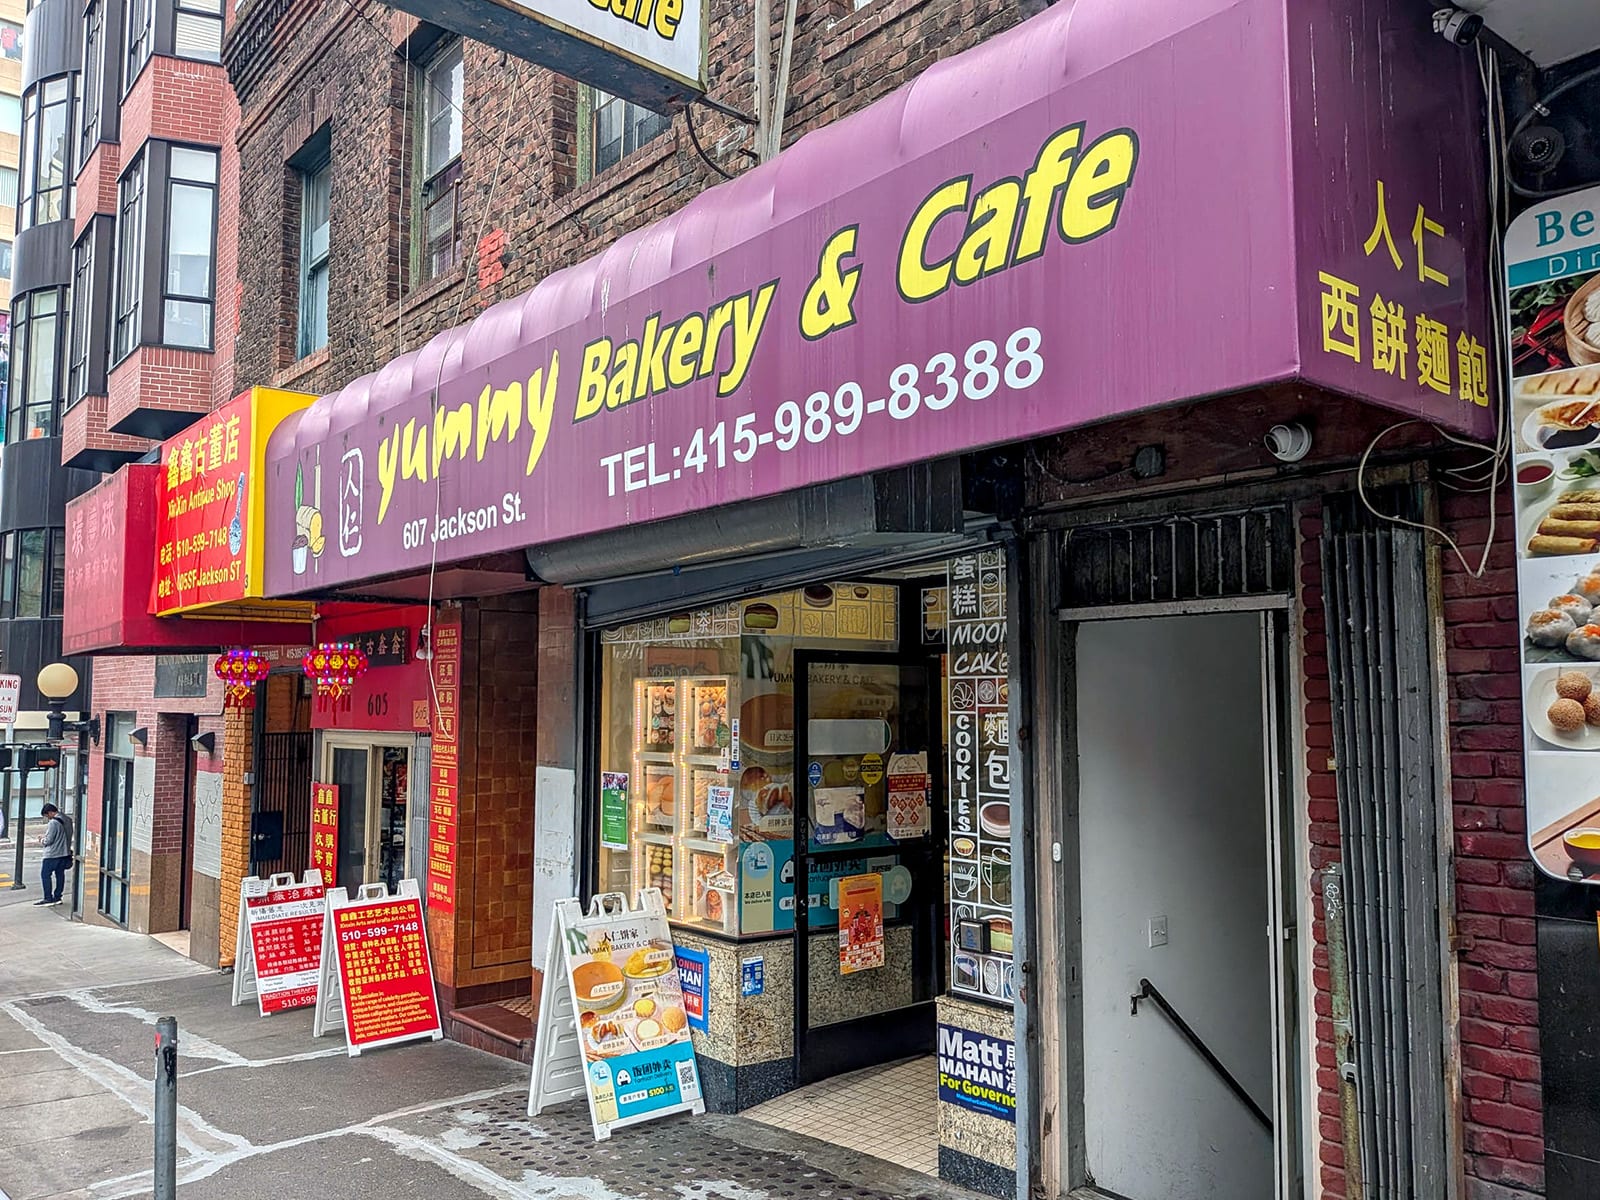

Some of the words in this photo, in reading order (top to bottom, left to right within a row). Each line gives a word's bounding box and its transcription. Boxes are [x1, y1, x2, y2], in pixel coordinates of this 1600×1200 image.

[1364, 180, 1449, 288] 人仁
[377, 349, 560, 525] yummy
[572, 277, 781, 425] Bakery
[799, 223, 864, 341] &
[896, 120, 1140, 304] Cafe
[1318, 270, 1489, 408] 西餅麵飽
[167, 413, 241, 492] 鑫鑫古董店
[188, 487, 215, 512] Antique
[216, 480, 236, 501] Shop
[403, 518, 428, 550] 607
[430, 505, 498, 543] Jackson
[502, 491, 526, 524] St.
[176, 526, 228, 559] 510-599-7148
[197, 563, 229, 588] Jackson
[229, 560, 242, 582] ST
[952, 555, 977, 616] 蛋糕
[696, 611, 711, 634] 茶
[768, 671, 795, 683] YUMM
[808, 673, 842, 685] BAKERY
[368, 692, 389, 717] 605
[955, 714, 972, 833] COOKIES
[314, 808, 336, 826] 古董行
[256, 911, 289, 921] IMMEDIATE
[290, 908, 318, 918] RESULTS
[341, 922, 418, 942] 510-599-7148
[586, 945, 610, 955] YUMMY
[611, 942, 635, 952] BAKERY
[643, 938, 659, 947] CAFE
[677, 957, 703, 973] ONNIE
[678, 968, 702, 987] HAN
[938, 1027, 1003, 1071] Matt
[939, 1056, 1003, 1089] MAHAN
[939, 1073, 961, 1091] For
[962, 1080, 1017, 1108] Governo
